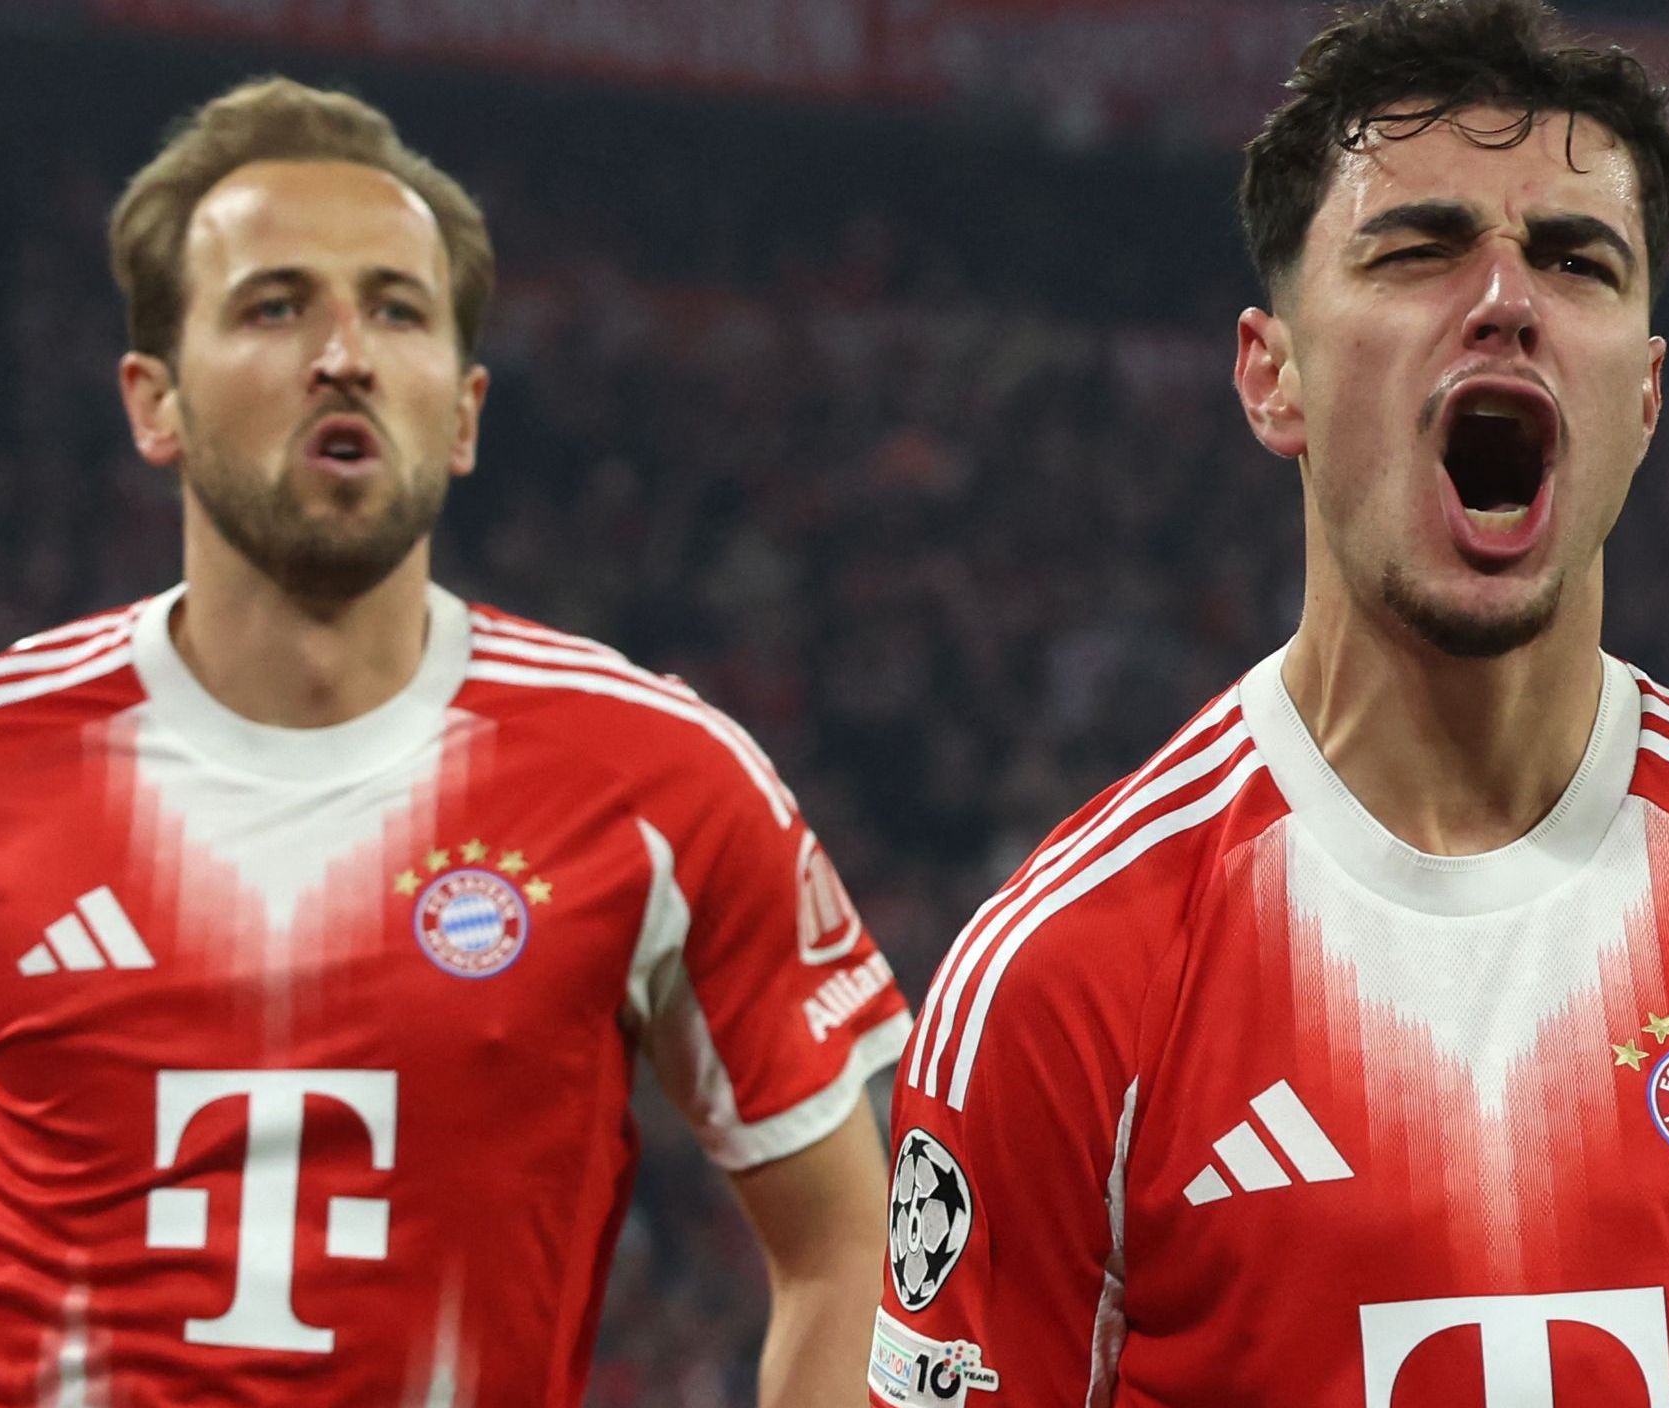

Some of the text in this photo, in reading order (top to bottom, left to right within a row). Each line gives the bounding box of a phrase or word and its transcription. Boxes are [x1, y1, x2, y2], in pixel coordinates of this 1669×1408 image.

[802, 949, 895, 1044] Allian
[146, 1068, 399, 1354] T
[915, 1353, 961, 1399] 10
[964, 1370, 995, 1384] YEARS
